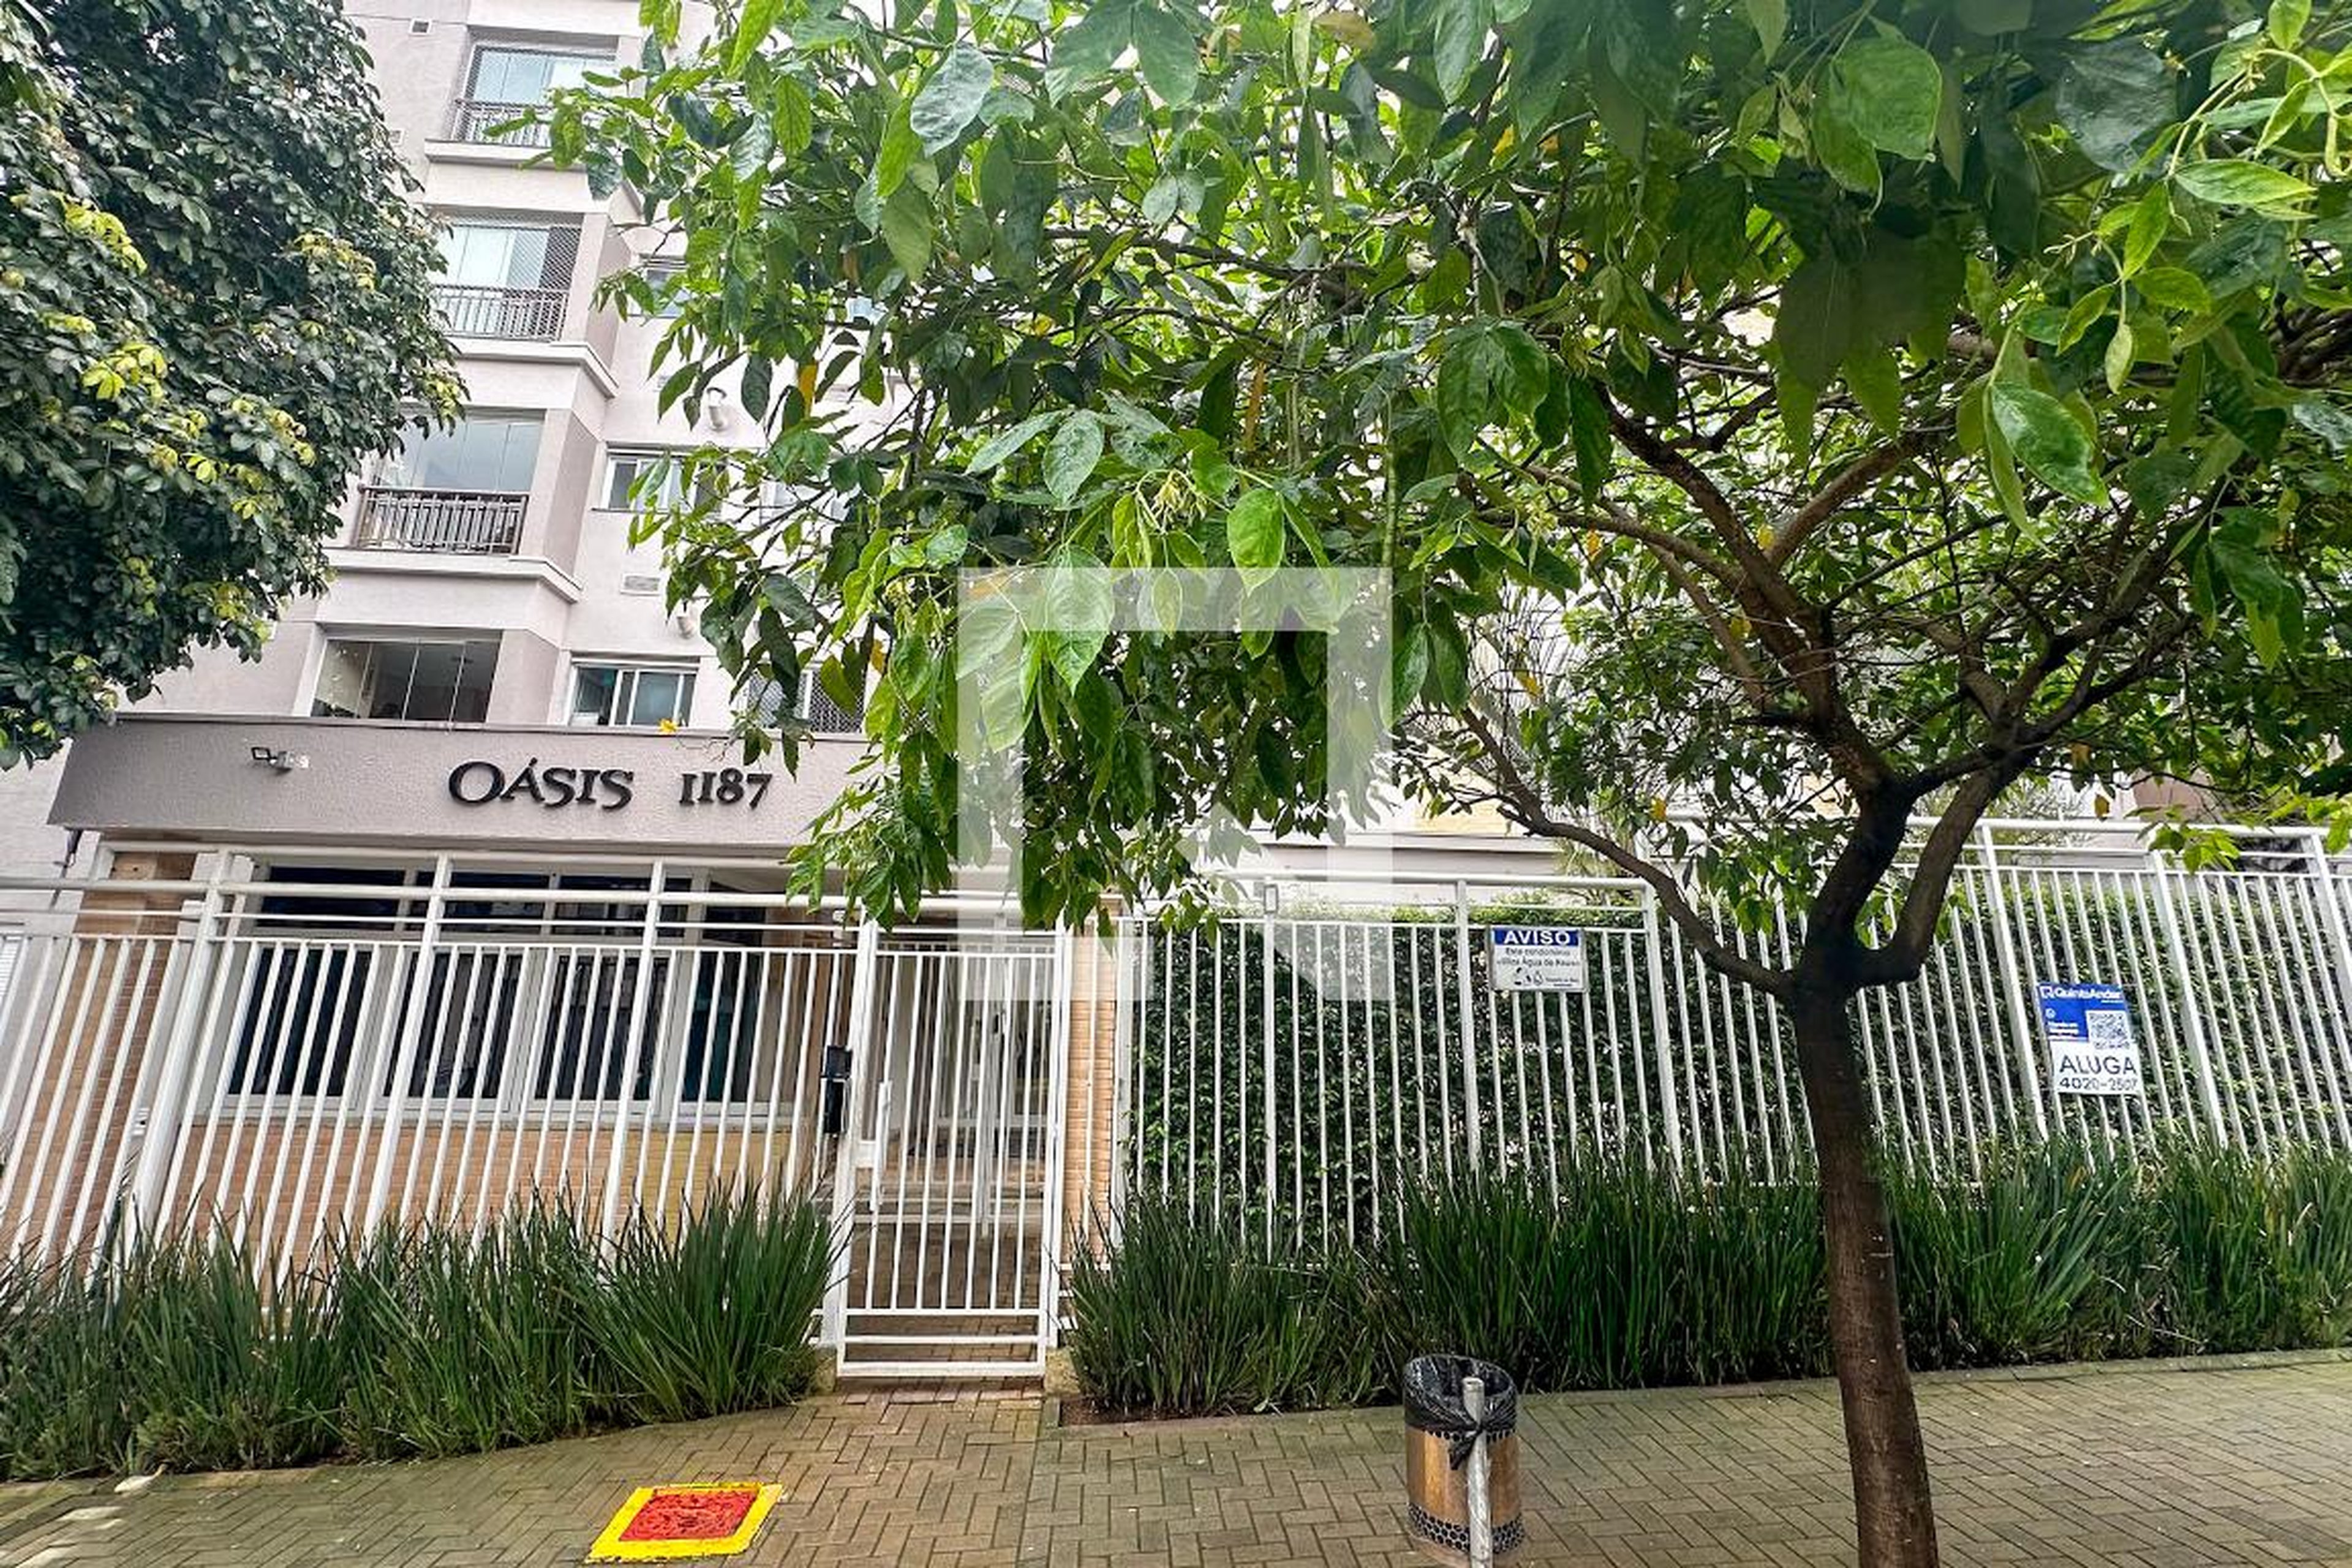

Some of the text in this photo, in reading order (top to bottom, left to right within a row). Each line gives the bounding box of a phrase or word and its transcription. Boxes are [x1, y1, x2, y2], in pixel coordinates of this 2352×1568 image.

[448, 757, 773, 812] OÁSIS 1187
[1504, 930, 1570, 944] AVISO
[2054, 987, 2122, 999] QuintoAndar
[2059, 1055, 2137, 1075] ALUGA
[2059, 1077, 2138, 1091] 4020-2507
